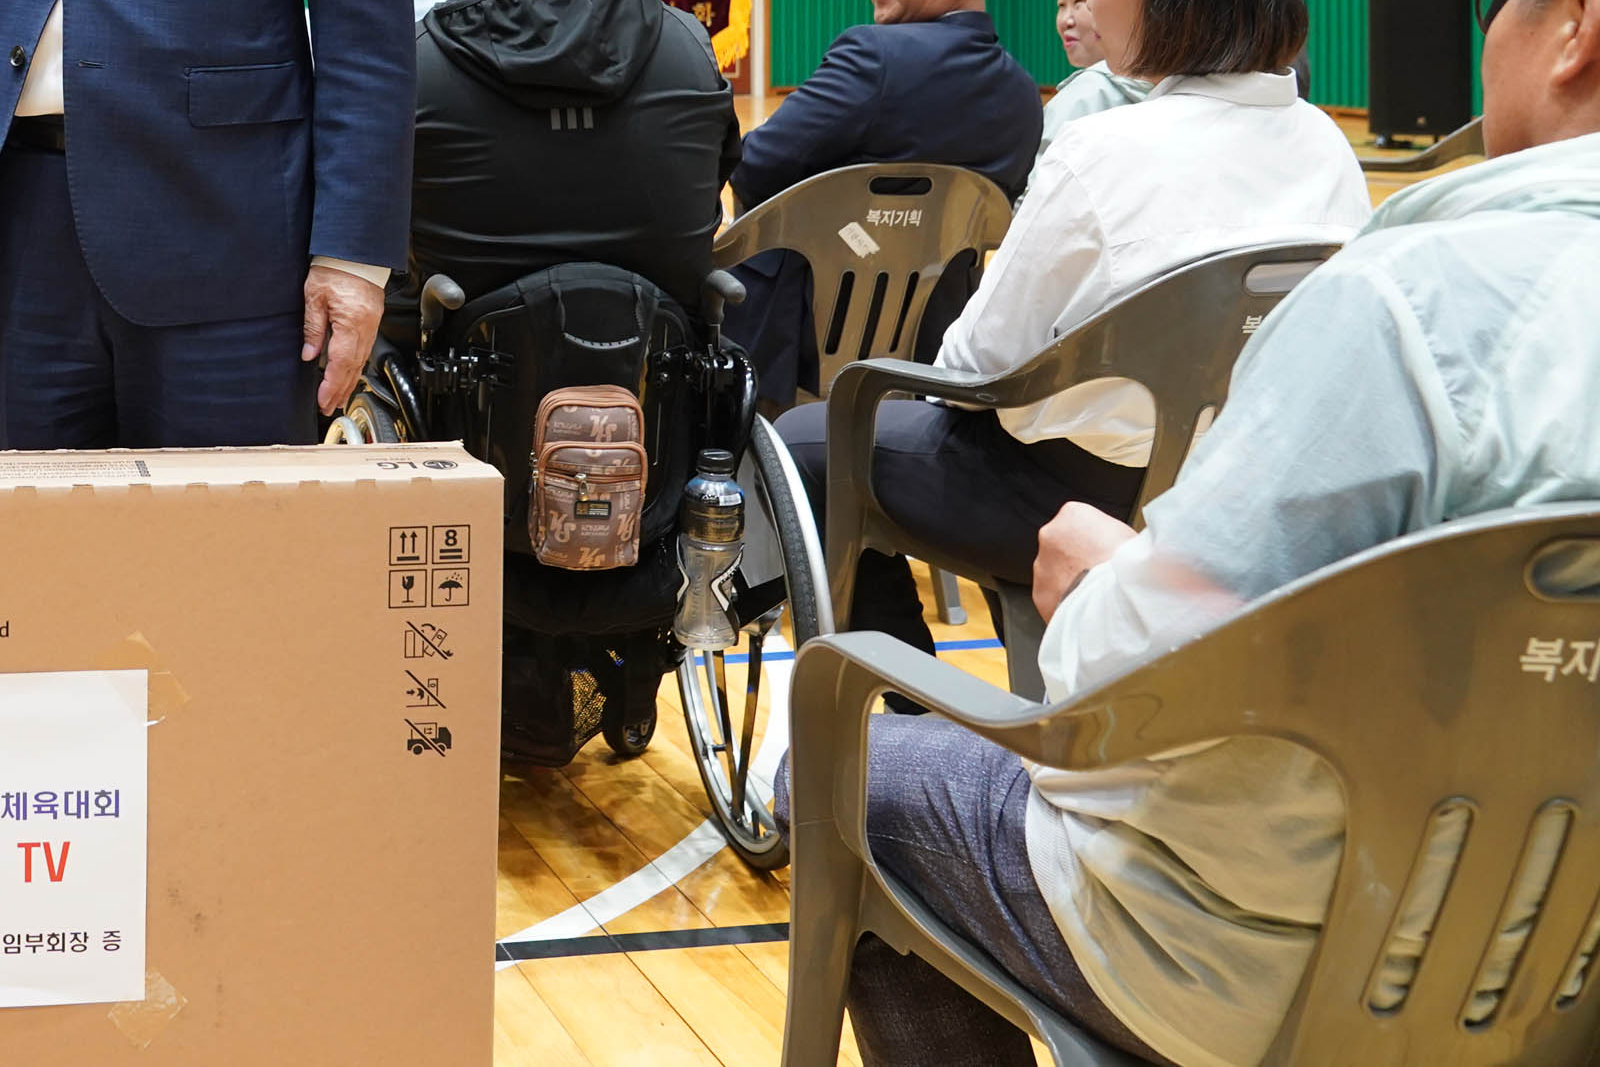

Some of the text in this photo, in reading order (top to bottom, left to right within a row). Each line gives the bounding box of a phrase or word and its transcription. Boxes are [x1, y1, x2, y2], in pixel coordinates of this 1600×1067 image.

[865, 208, 923, 227] 복지기획
[444, 529, 458, 546] 8
[16, 841, 71, 883] TV
[102, 930, 122, 952] 증
